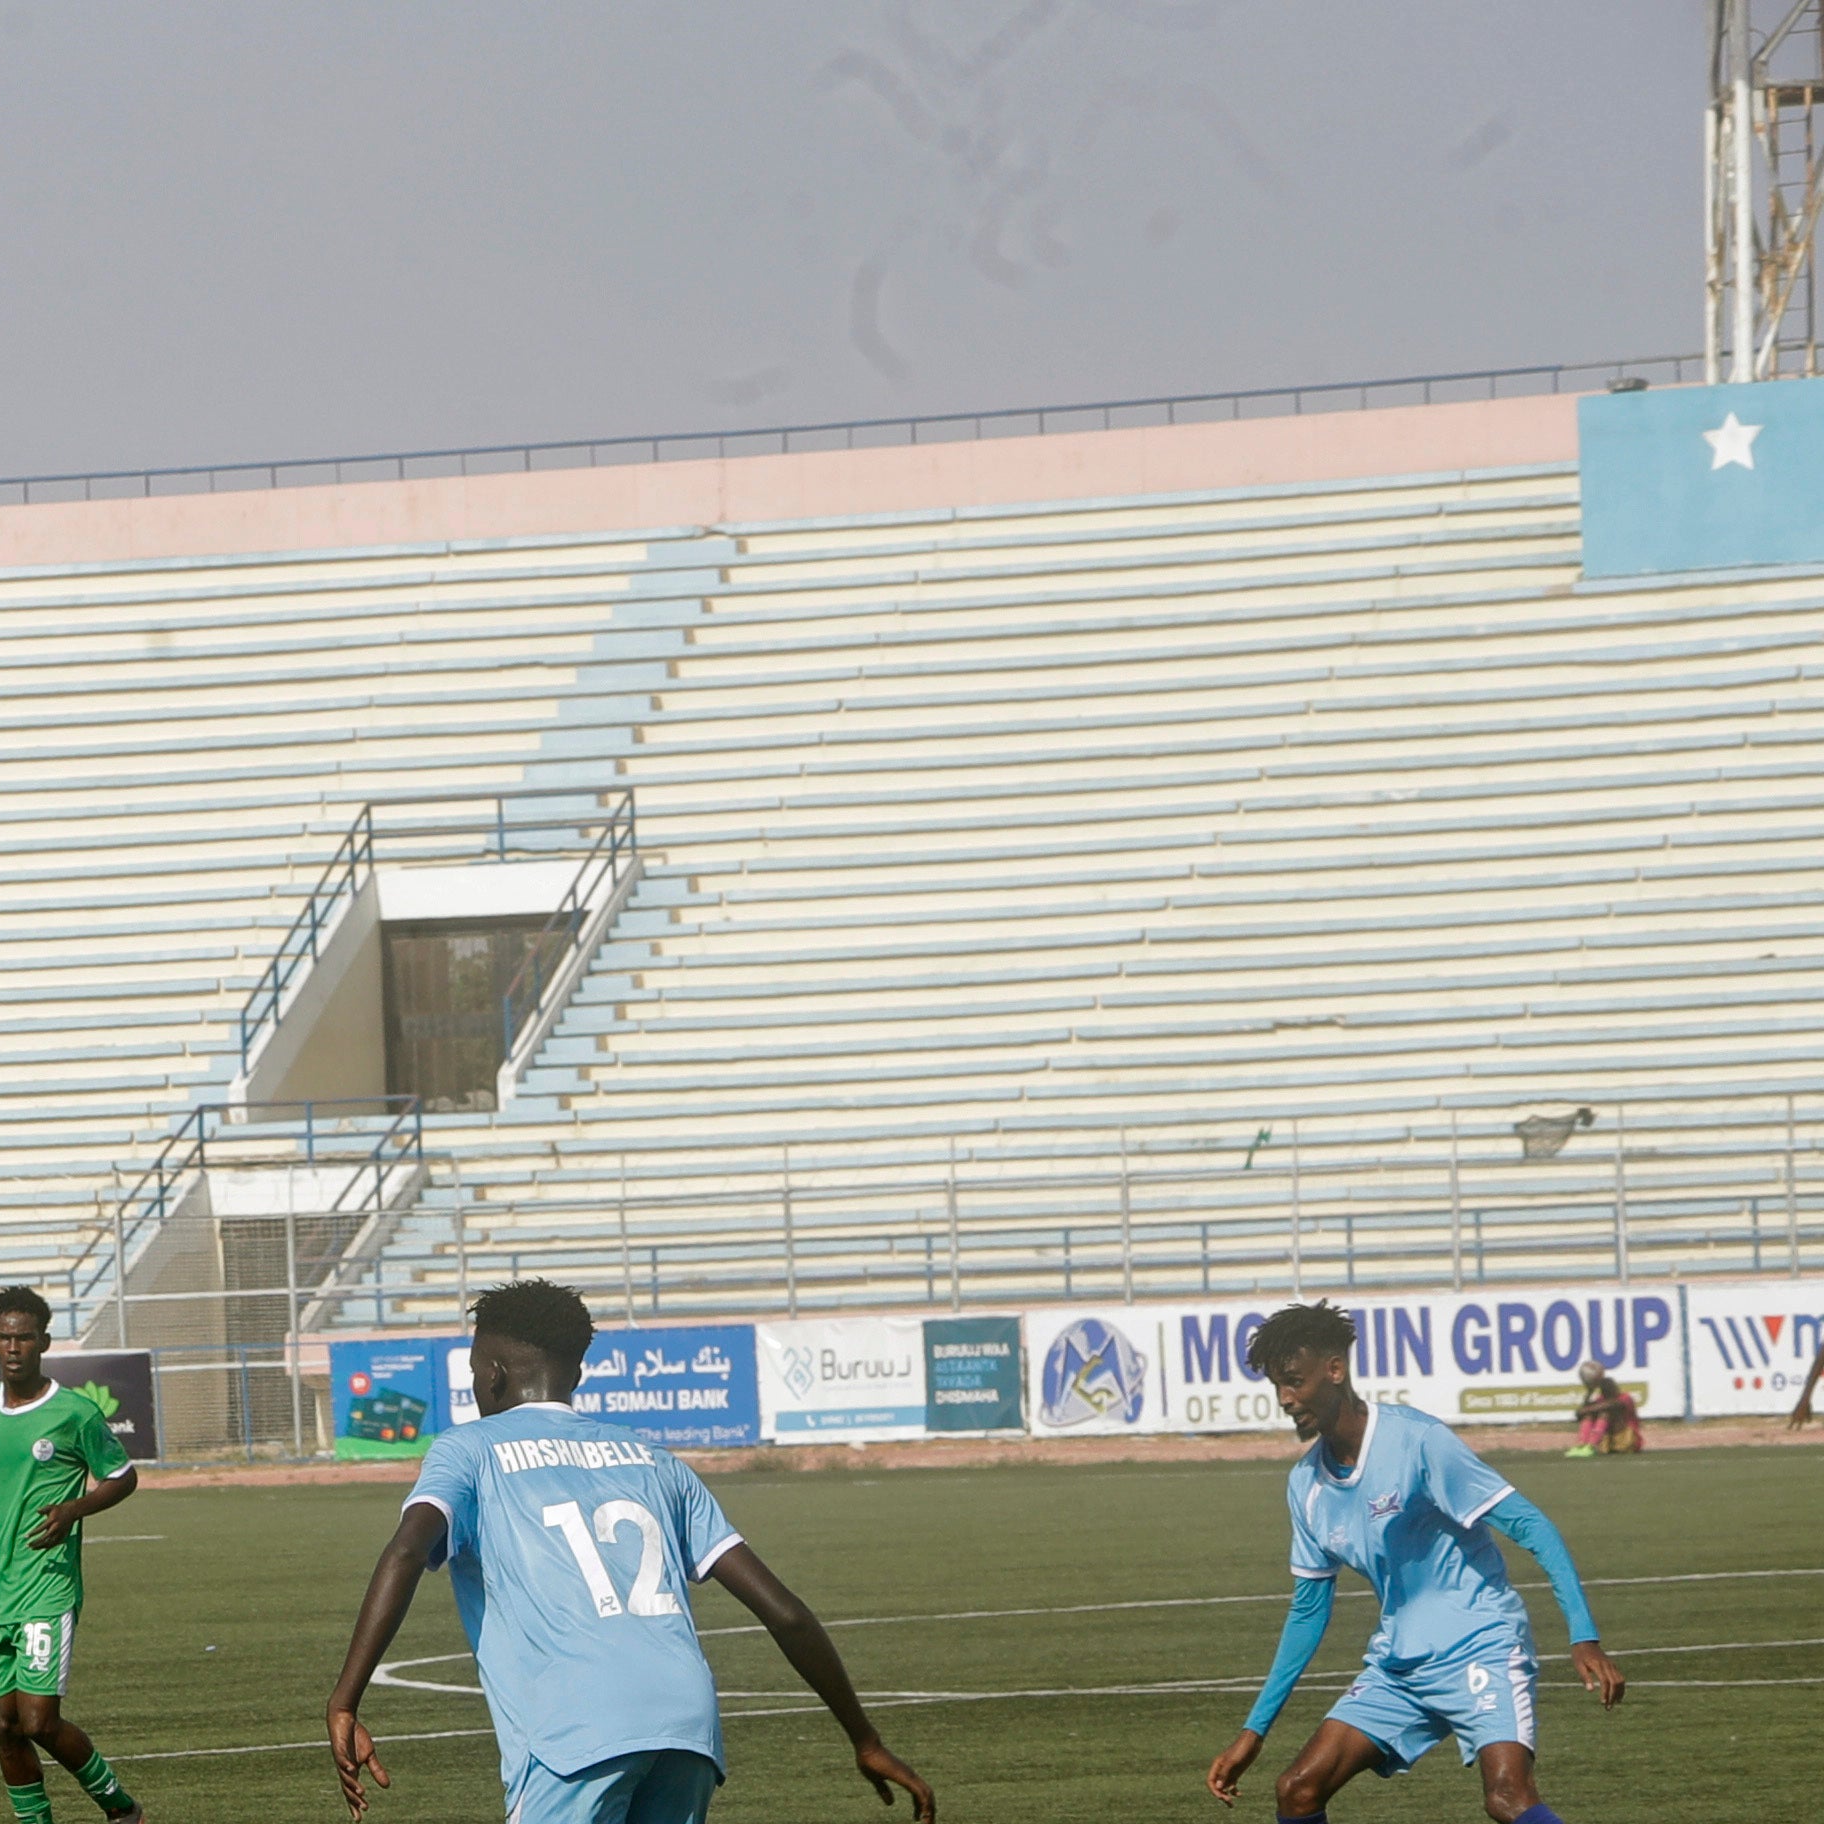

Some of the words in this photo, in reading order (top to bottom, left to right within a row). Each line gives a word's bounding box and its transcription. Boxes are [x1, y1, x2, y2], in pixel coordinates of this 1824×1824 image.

[1181, 1306, 1434, 1383] MOIN
[1452, 1296, 1672, 1376] GROUP
[633, 1348, 687, 1388] سلام
[690, 1347, 732, 1380] بنك
[606, 1390, 675, 1413] SOMALI
[677, 1388, 730, 1411] BANK
[1186, 1395, 1222, 1424] OF
[663, 1426, 711, 1444] leading
[493, 1438, 656, 1474] HIRSHABELLE
[542, 1499, 683, 1619] 12
[23, 1622, 52, 1657] 16
[1467, 1660, 1490, 1695] 6
